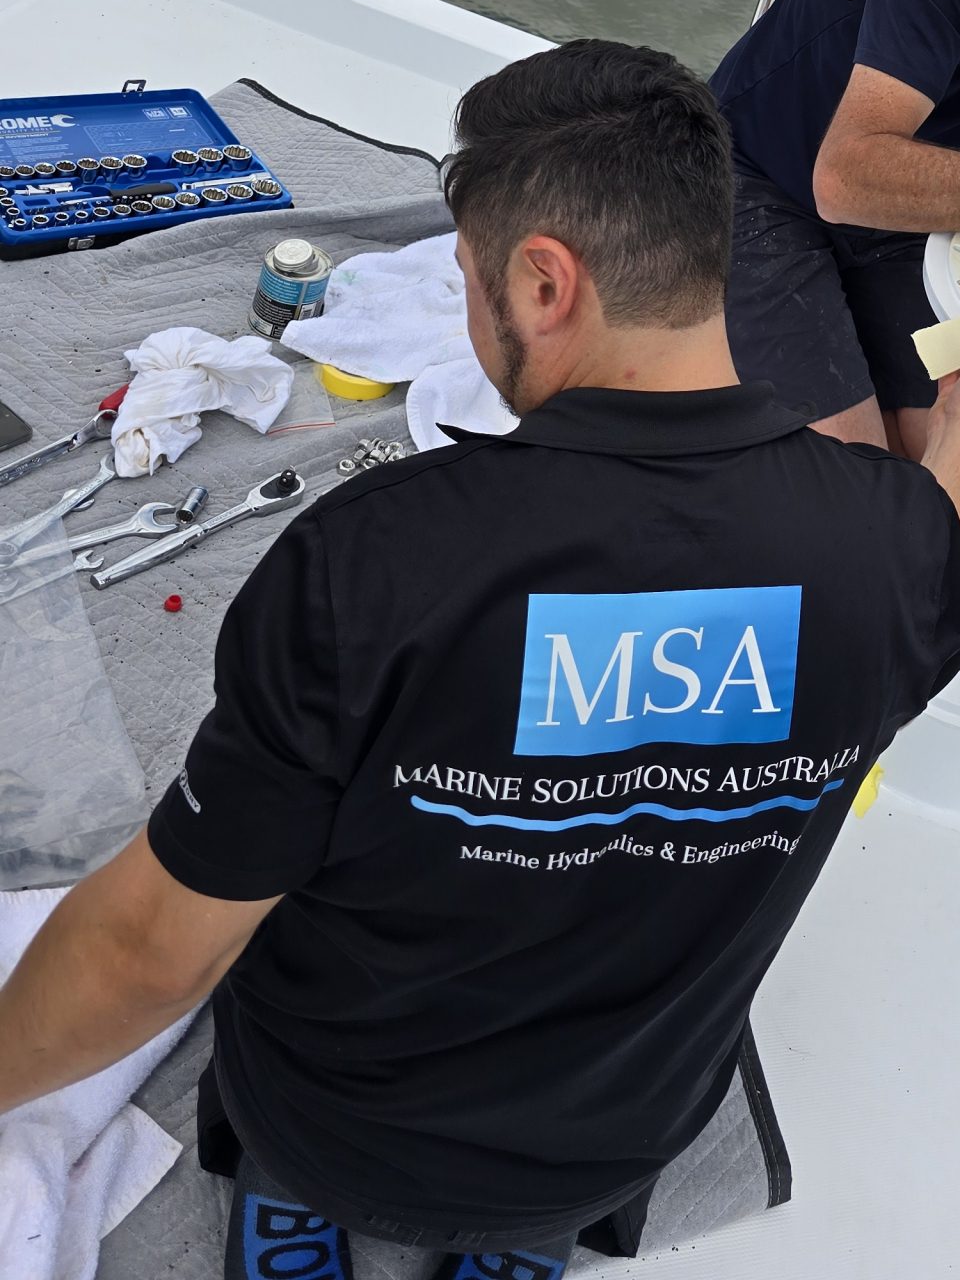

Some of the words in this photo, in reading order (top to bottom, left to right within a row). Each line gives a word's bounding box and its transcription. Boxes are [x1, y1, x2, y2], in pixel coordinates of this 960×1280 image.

[0, 116, 52, 130] OME
[536, 625, 781, 726] MSA
[392, 763, 523, 801] MARINE
[531, 764, 710, 804] SOLUTIONS
[717, 744, 860, 793] AUSTRALIA
[459, 845, 540, 870] Marine
[545, 833, 654, 871] Hydraulics
[660, 841, 677, 862] &
[681, 830, 802, 865] Engineering
[256, 1203, 331, 1280] BO
